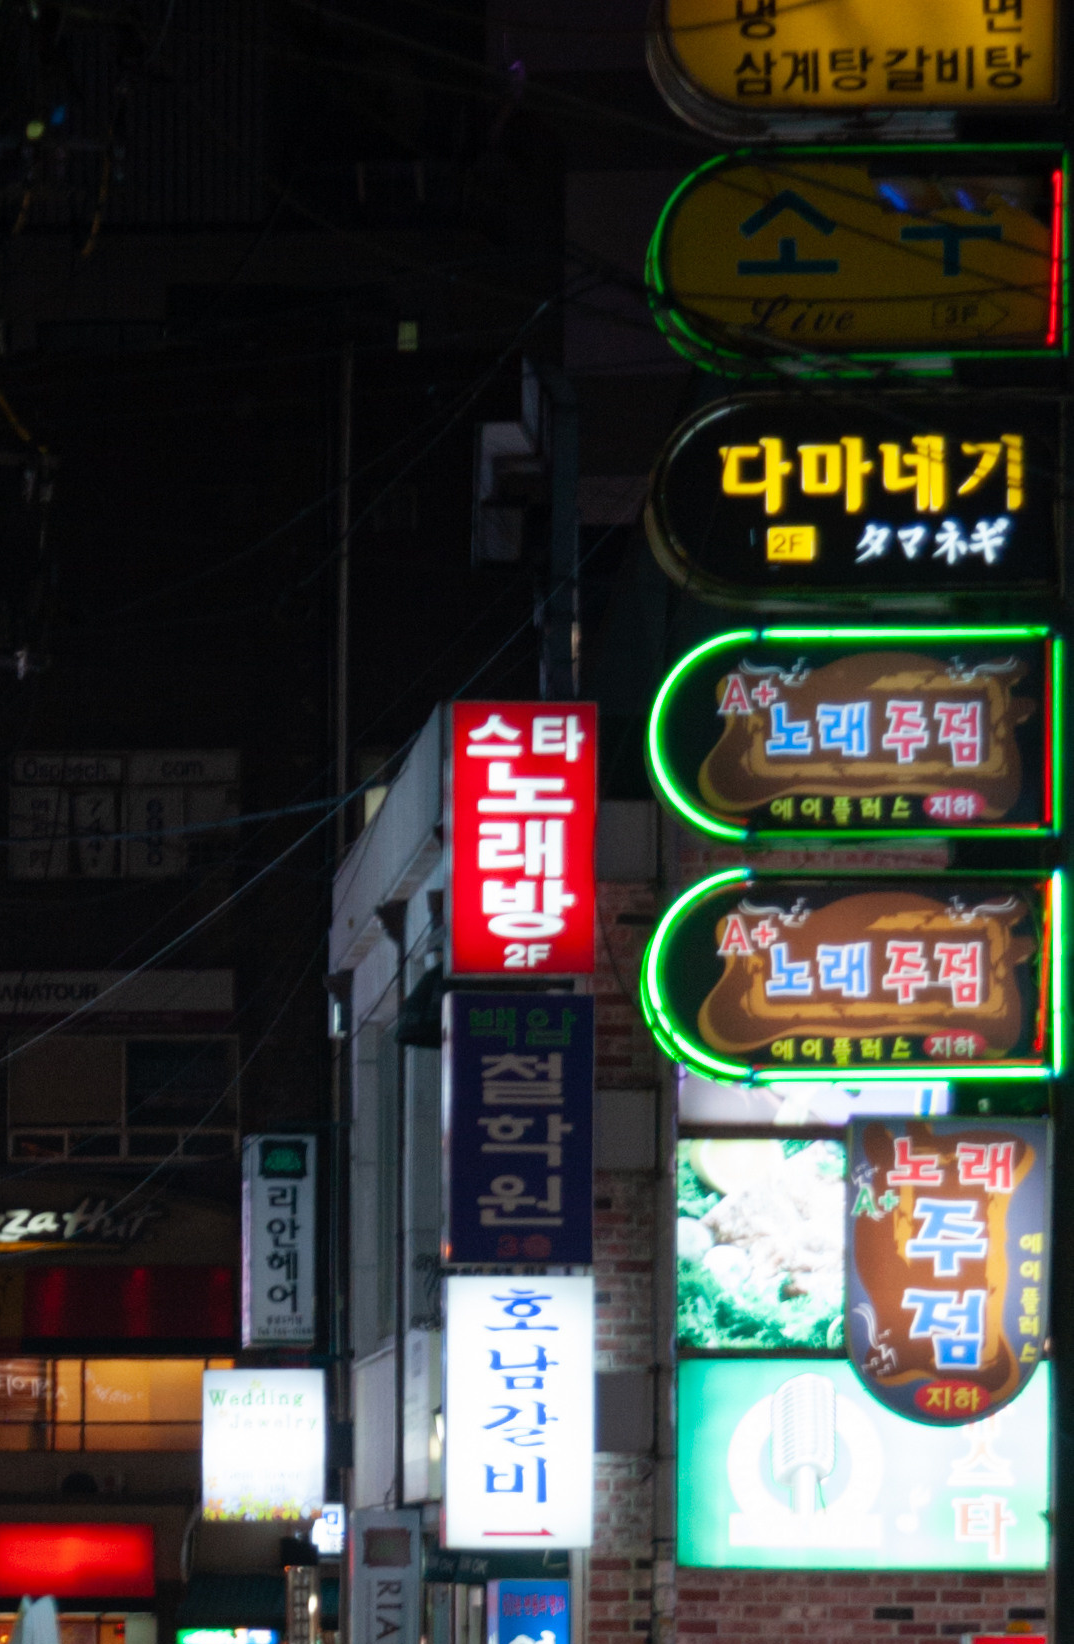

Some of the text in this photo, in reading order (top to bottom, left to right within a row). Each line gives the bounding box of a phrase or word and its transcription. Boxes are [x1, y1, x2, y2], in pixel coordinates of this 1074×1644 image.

[734, 47, 1032, 96] 삼계탕 갈비탕
[744, 294, 855, 335] Live
[718, 434, 1024, 514] 다마네기
[772, 535, 804, 553] 2F
[855, 516, 1014, 566] タマネギ
[717, 673, 779, 716] A+
[465, 713, 586, 762] 스타
[769, 796, 912, 826] 에이플러스
[929, 793, 977, 819] 지하
[477, 761, 577, 940] 노래방
[502, 943, 552, 968] 2F
[717, 913, 779, 957] A+
[769, 1036, 912, 1066] 에이플러스
[929, 1033, 977, 1059] 지하
[476, 1051, 575, 1227] 철학원
[850, 1184, 901, 1217] A+
[266, 1184, 301, 1314] 리안헤어
[1019, 1232, 1043, 1365] 에이플러스
[207, 1388, 305, 1408] Wedding
[482, 1288, 560, 1503] 호남갈비
[925, 1384, 981, 1413] 지하
[229, 1412, 319, 1431] Jewelry
